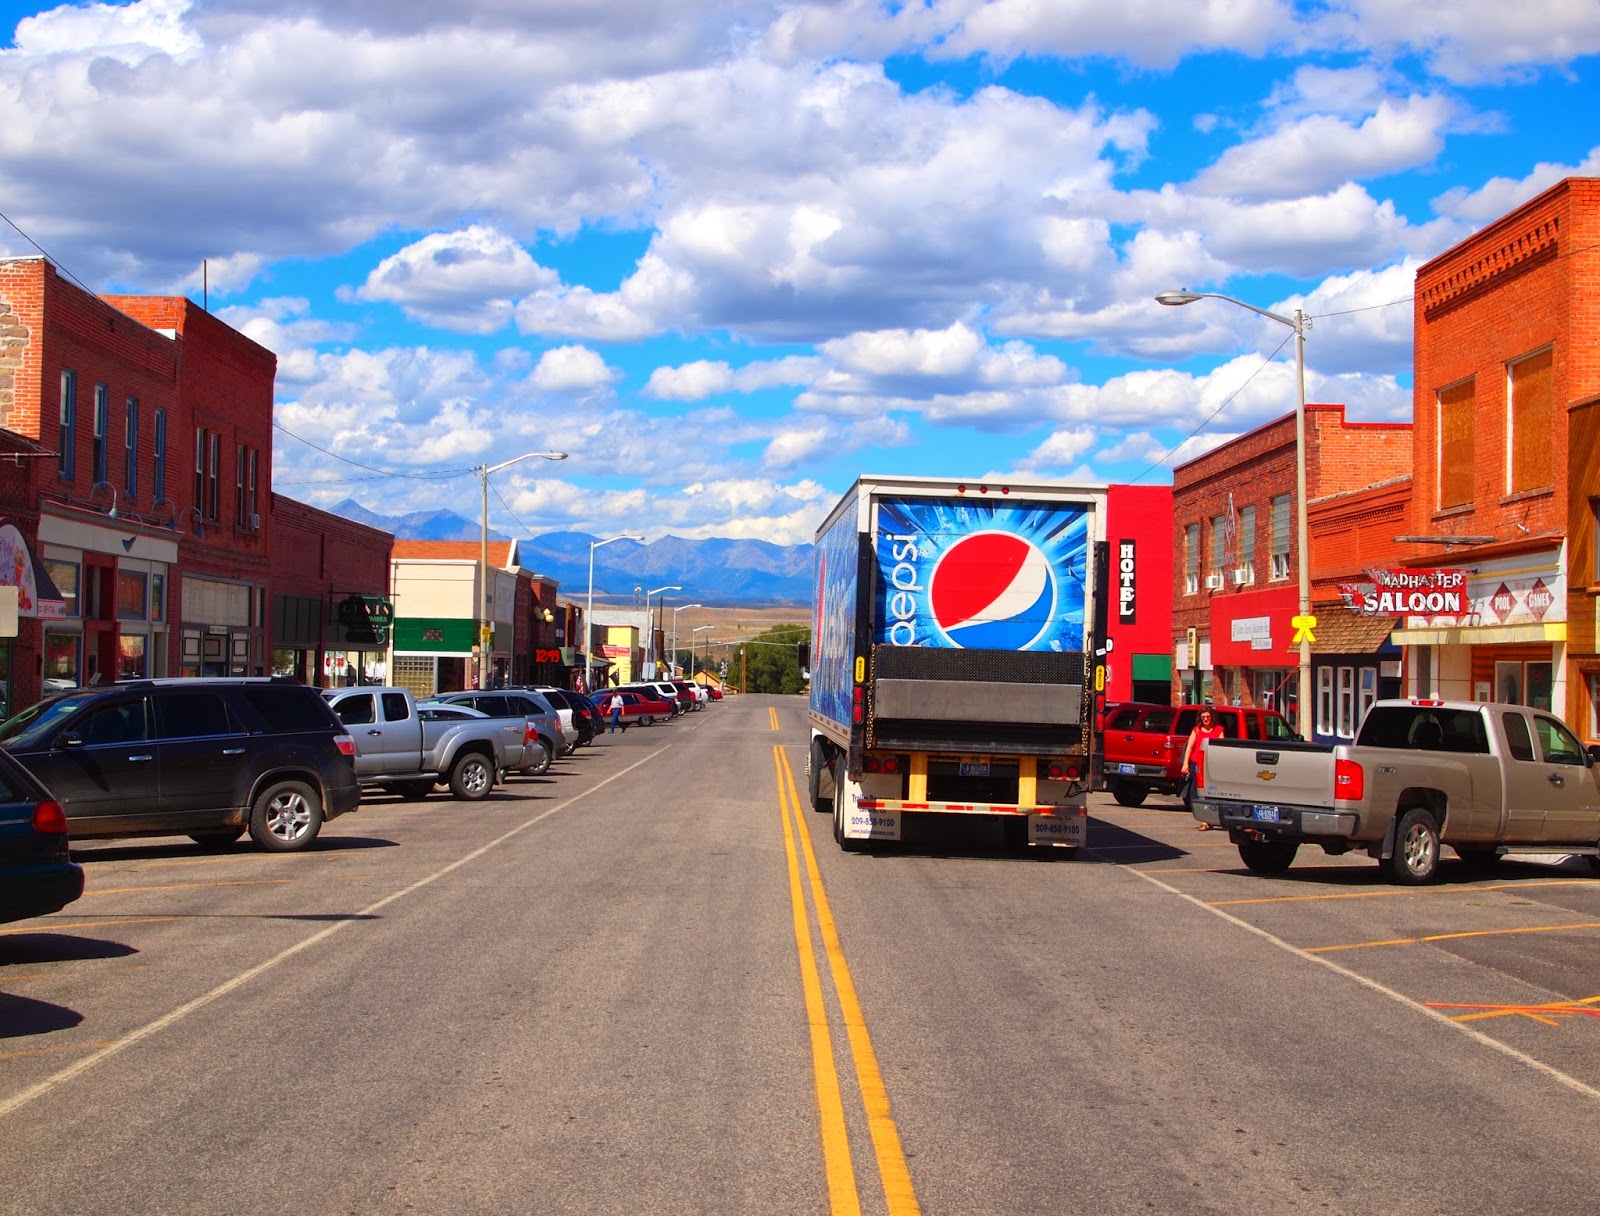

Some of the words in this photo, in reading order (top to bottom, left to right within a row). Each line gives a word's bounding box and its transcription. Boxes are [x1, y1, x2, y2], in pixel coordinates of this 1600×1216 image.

[1120, 544, 1135, 615] HOTEL
[1380, 573, 1463, 588] MADHATTER
[886, 535, 923, 647] pepsi
[1364, 592, 1460, 612] SALOON
[1494, 596, 1511, 610] POOL
[1528, 592, 1550, 608] GAMES
[851, 816, 895, 827] 209-858-9100
[1035, 824, 1080, 834] 209-858-9100
